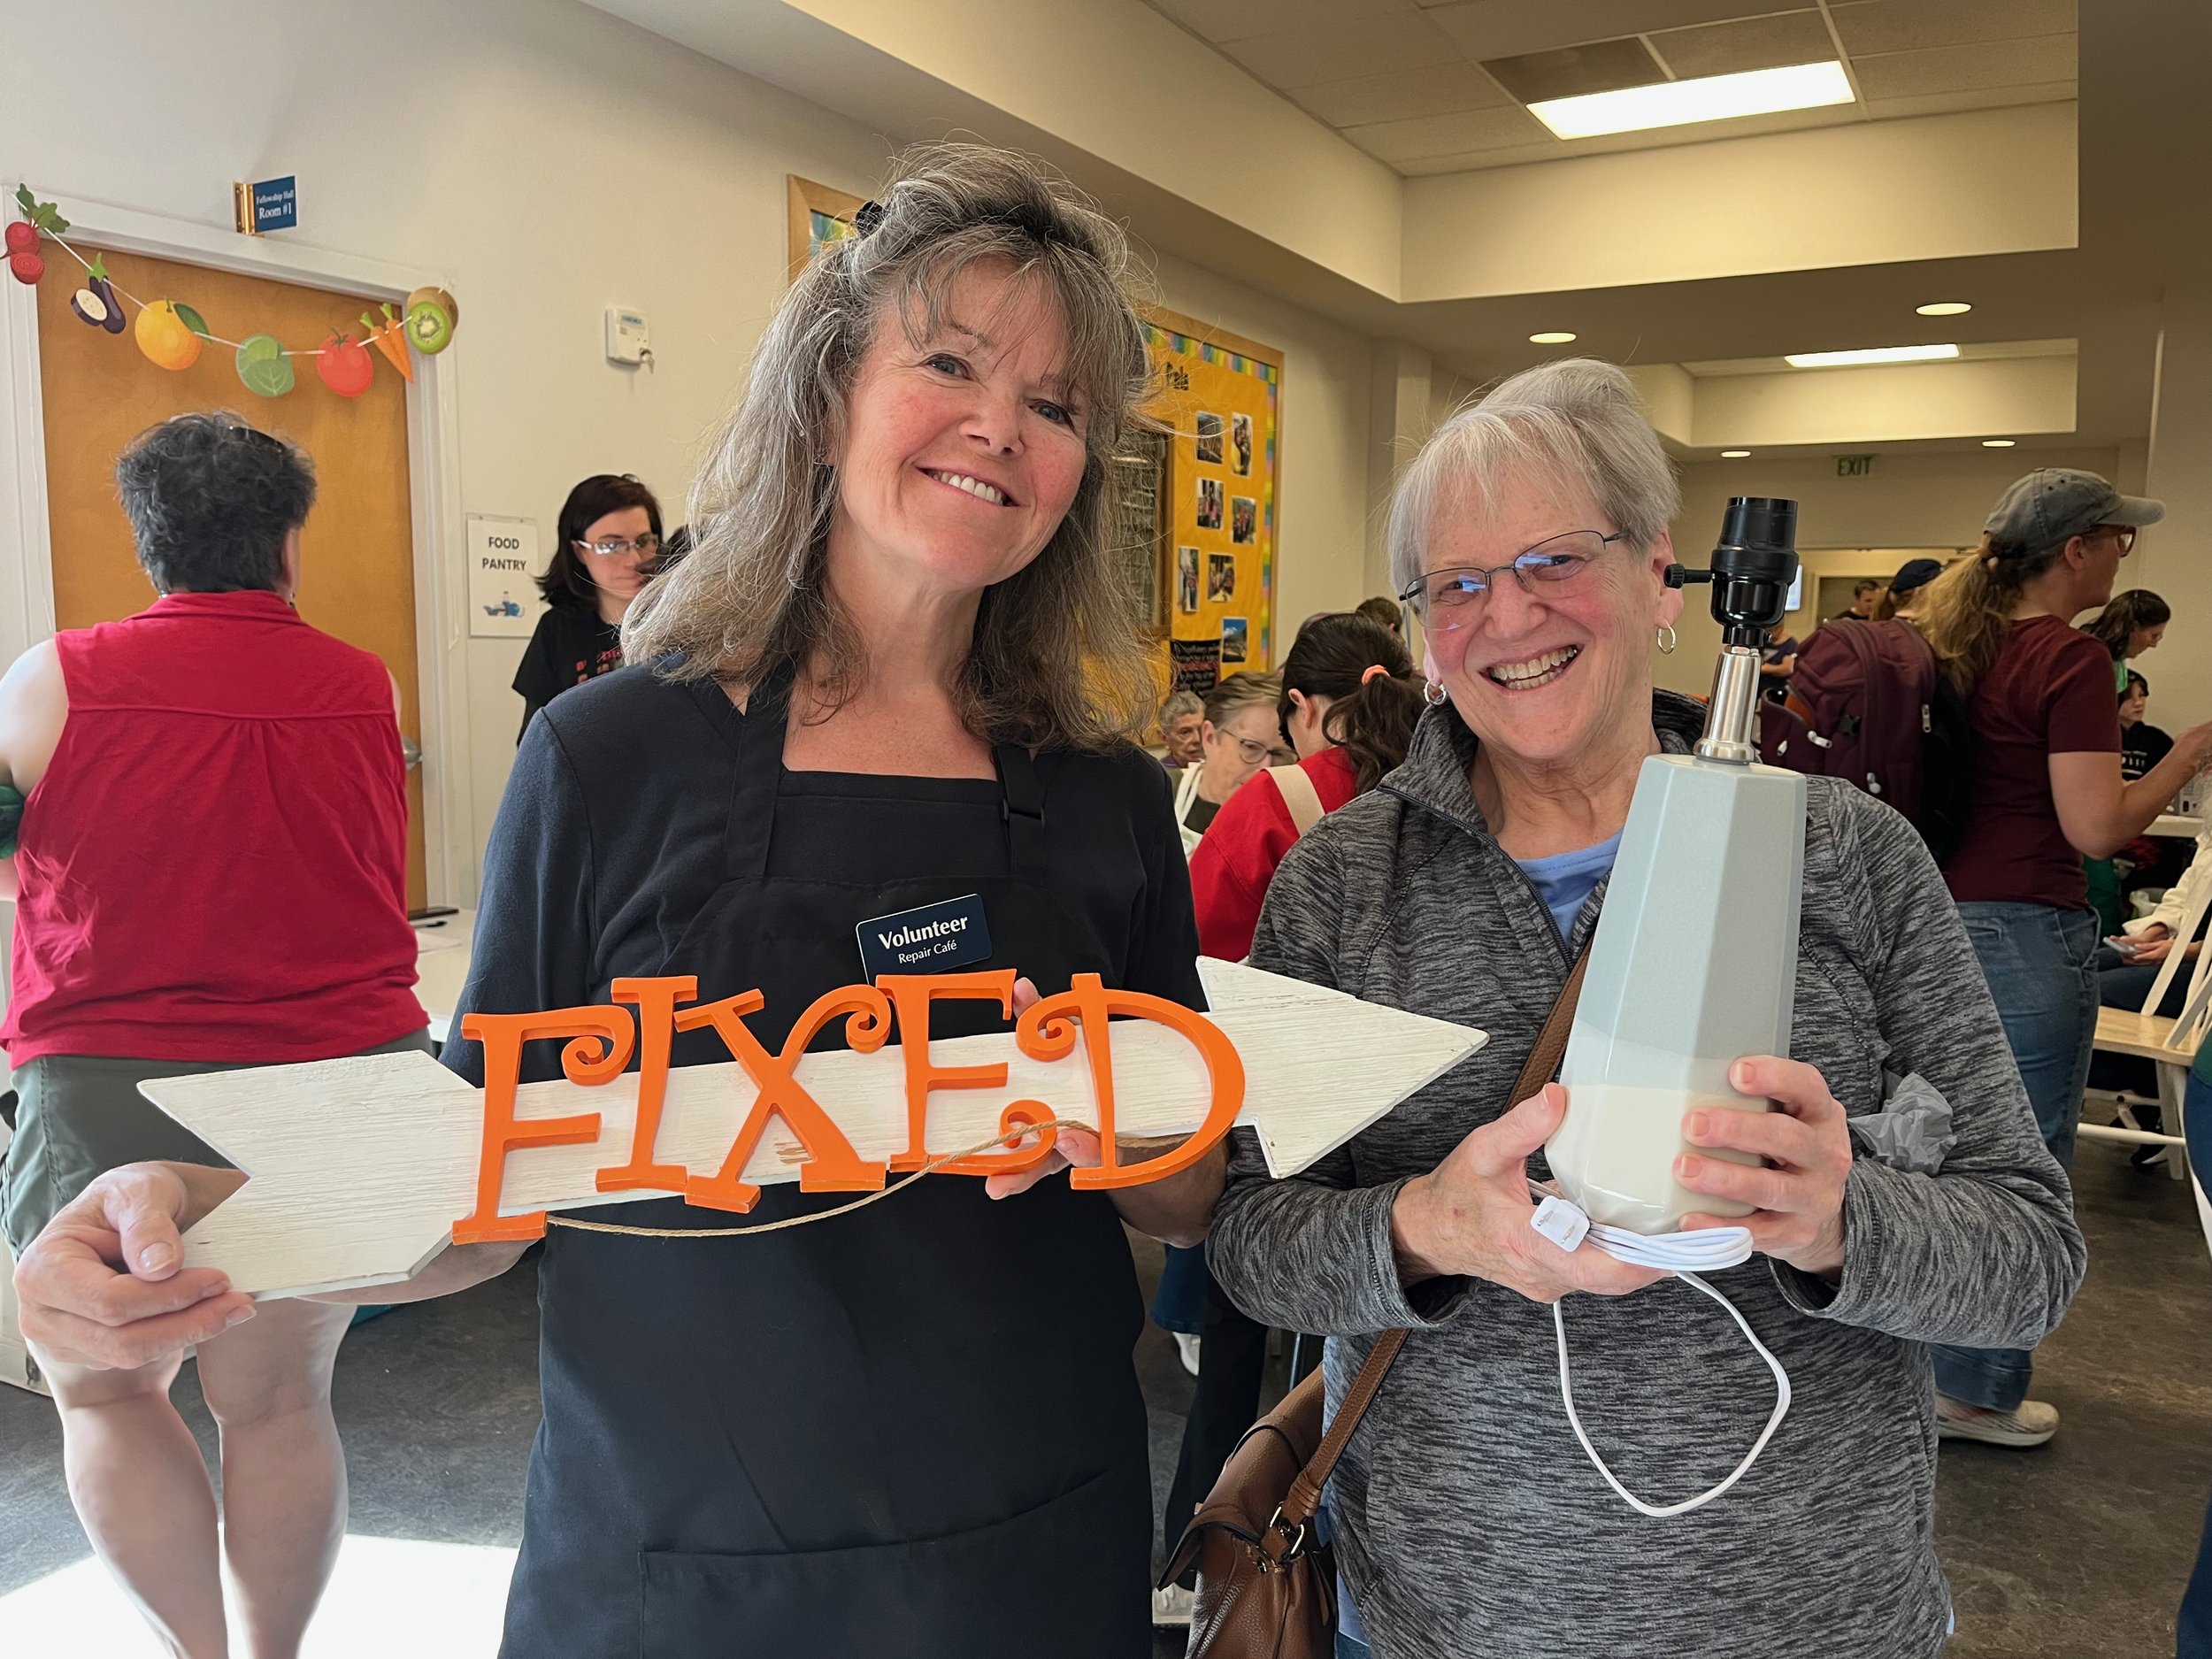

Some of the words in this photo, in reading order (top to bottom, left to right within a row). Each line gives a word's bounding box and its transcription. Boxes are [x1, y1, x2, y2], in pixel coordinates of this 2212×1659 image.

[258, 207, 281, 220] Room
[283, 202, 292, 215] #1
[1838, 457, 1870, 476] EXIT
[488, 536, 520, 549] FOOD
[482, 557, 526, 571] PANTRY
[878, 916, 969, 950] Volunteer
[898, 947, 932, 964] Repair
[933, 939, 957, 955] Café
[452, 969, 1246, 1244] FIXED
